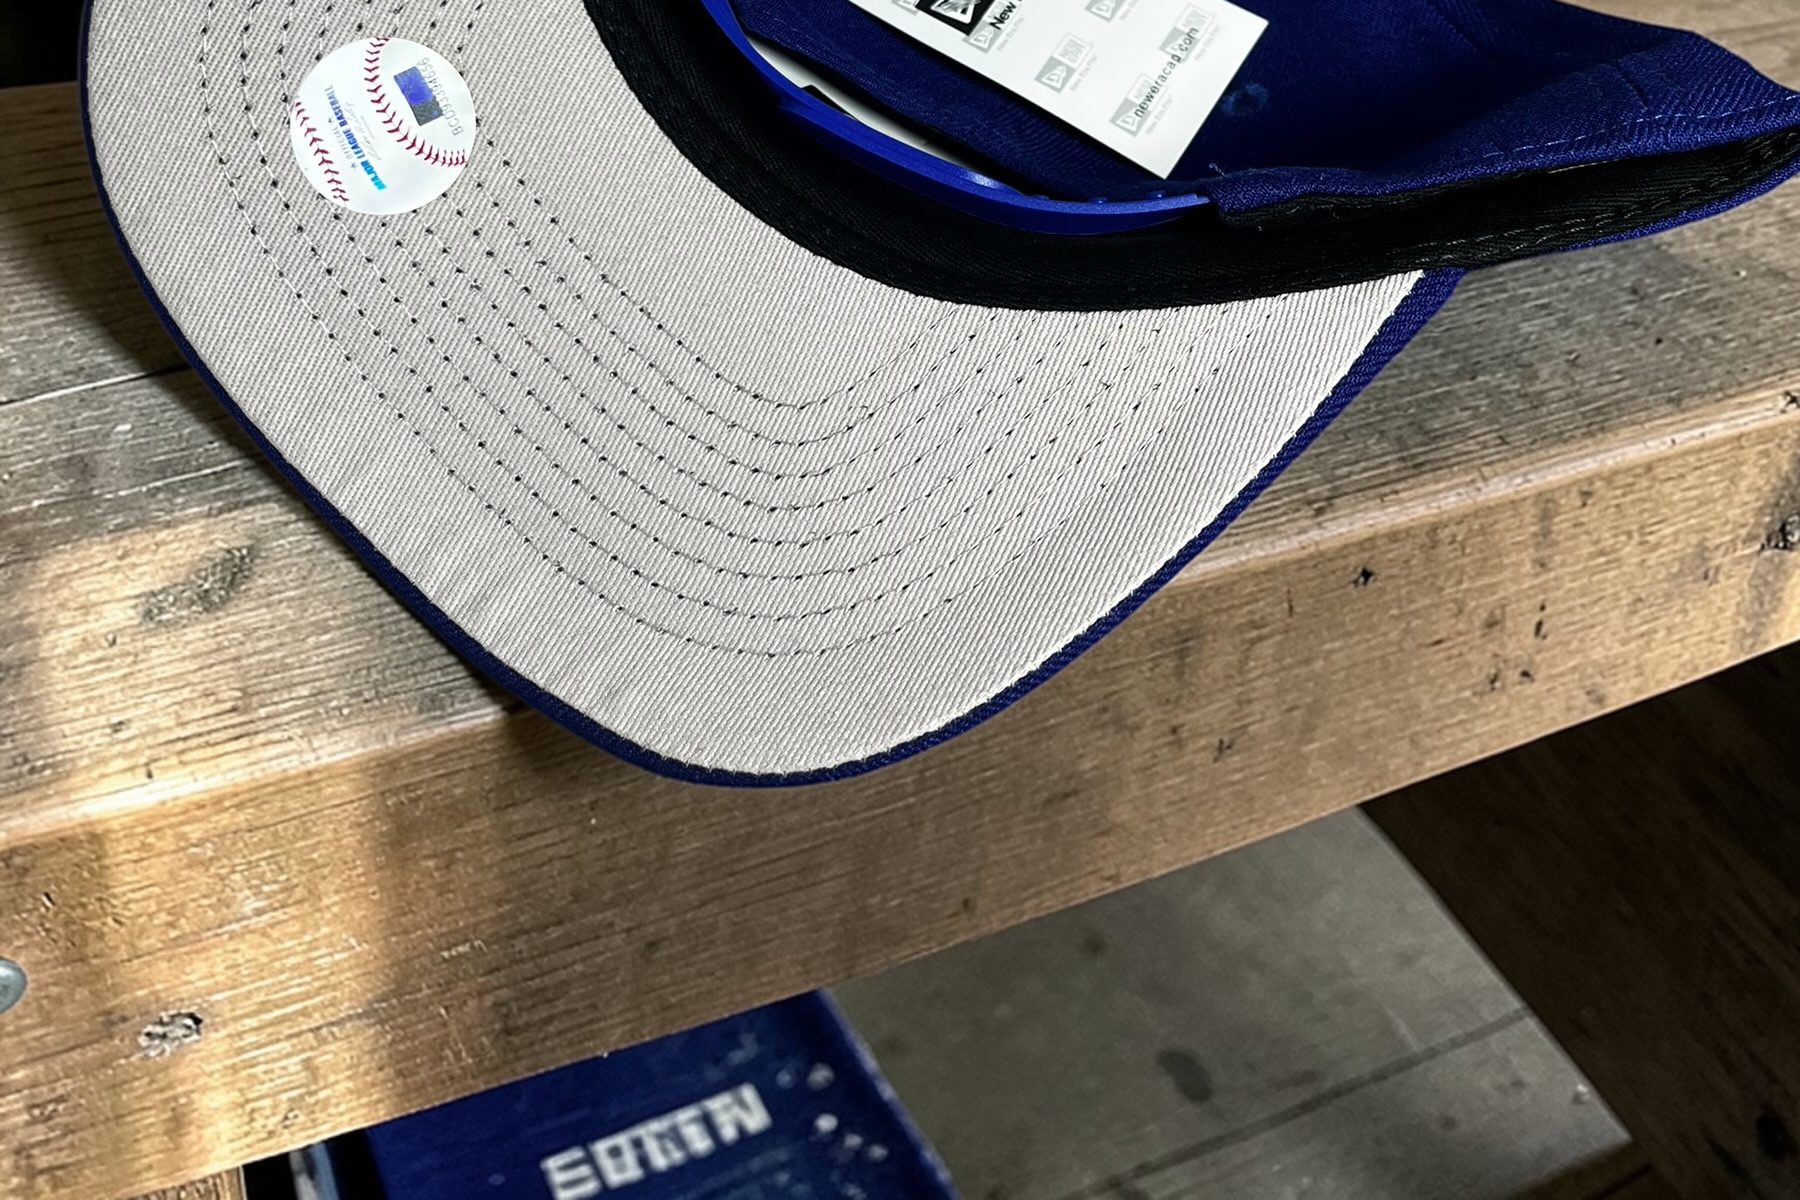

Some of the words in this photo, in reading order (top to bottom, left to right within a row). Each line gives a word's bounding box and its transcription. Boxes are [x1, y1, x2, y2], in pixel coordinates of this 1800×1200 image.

[988, 3, 1017, 30] New
[1134, 27, 1199, 119] neweracap.com
[324, 84, 349, 128] BASEBALL
[343, 128, 366, 160] LEAGUE
[360, 158, 387, 191] MAJOR
